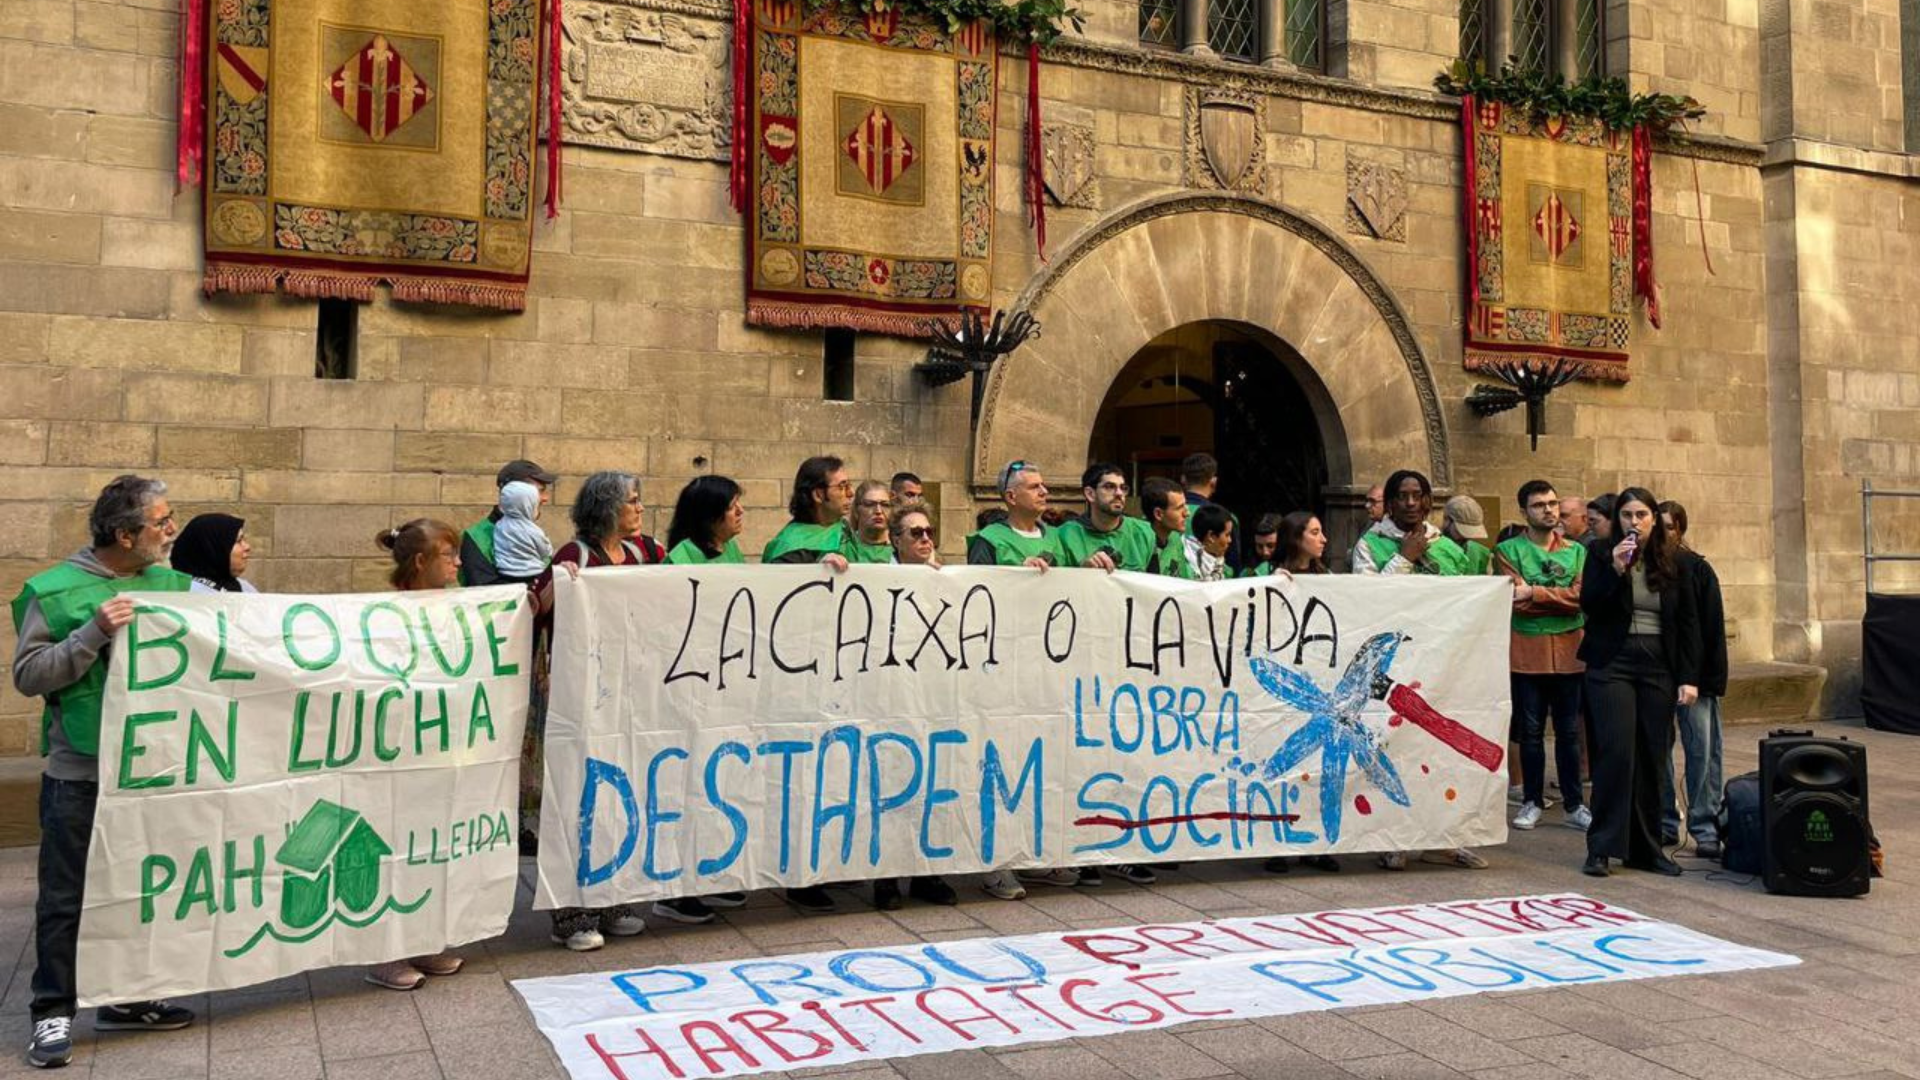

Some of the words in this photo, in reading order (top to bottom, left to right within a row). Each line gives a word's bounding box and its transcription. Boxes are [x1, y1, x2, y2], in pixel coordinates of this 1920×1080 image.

[127, 600, 519, 692] BLOQUE
[1044, 598, 1076, 663] O
[117, 700, 238, 790] EN
[287, 681, 495, 774] LUCHA
[1075, 675, 1239, 756] L'OBRA
[407, 811, 511, 867] LLEIDA
[577, 725, 1043, 888] DESTAPEM
[141, 834, 265, 925] PAH
[611, 945, 1047, 1013] PROU
